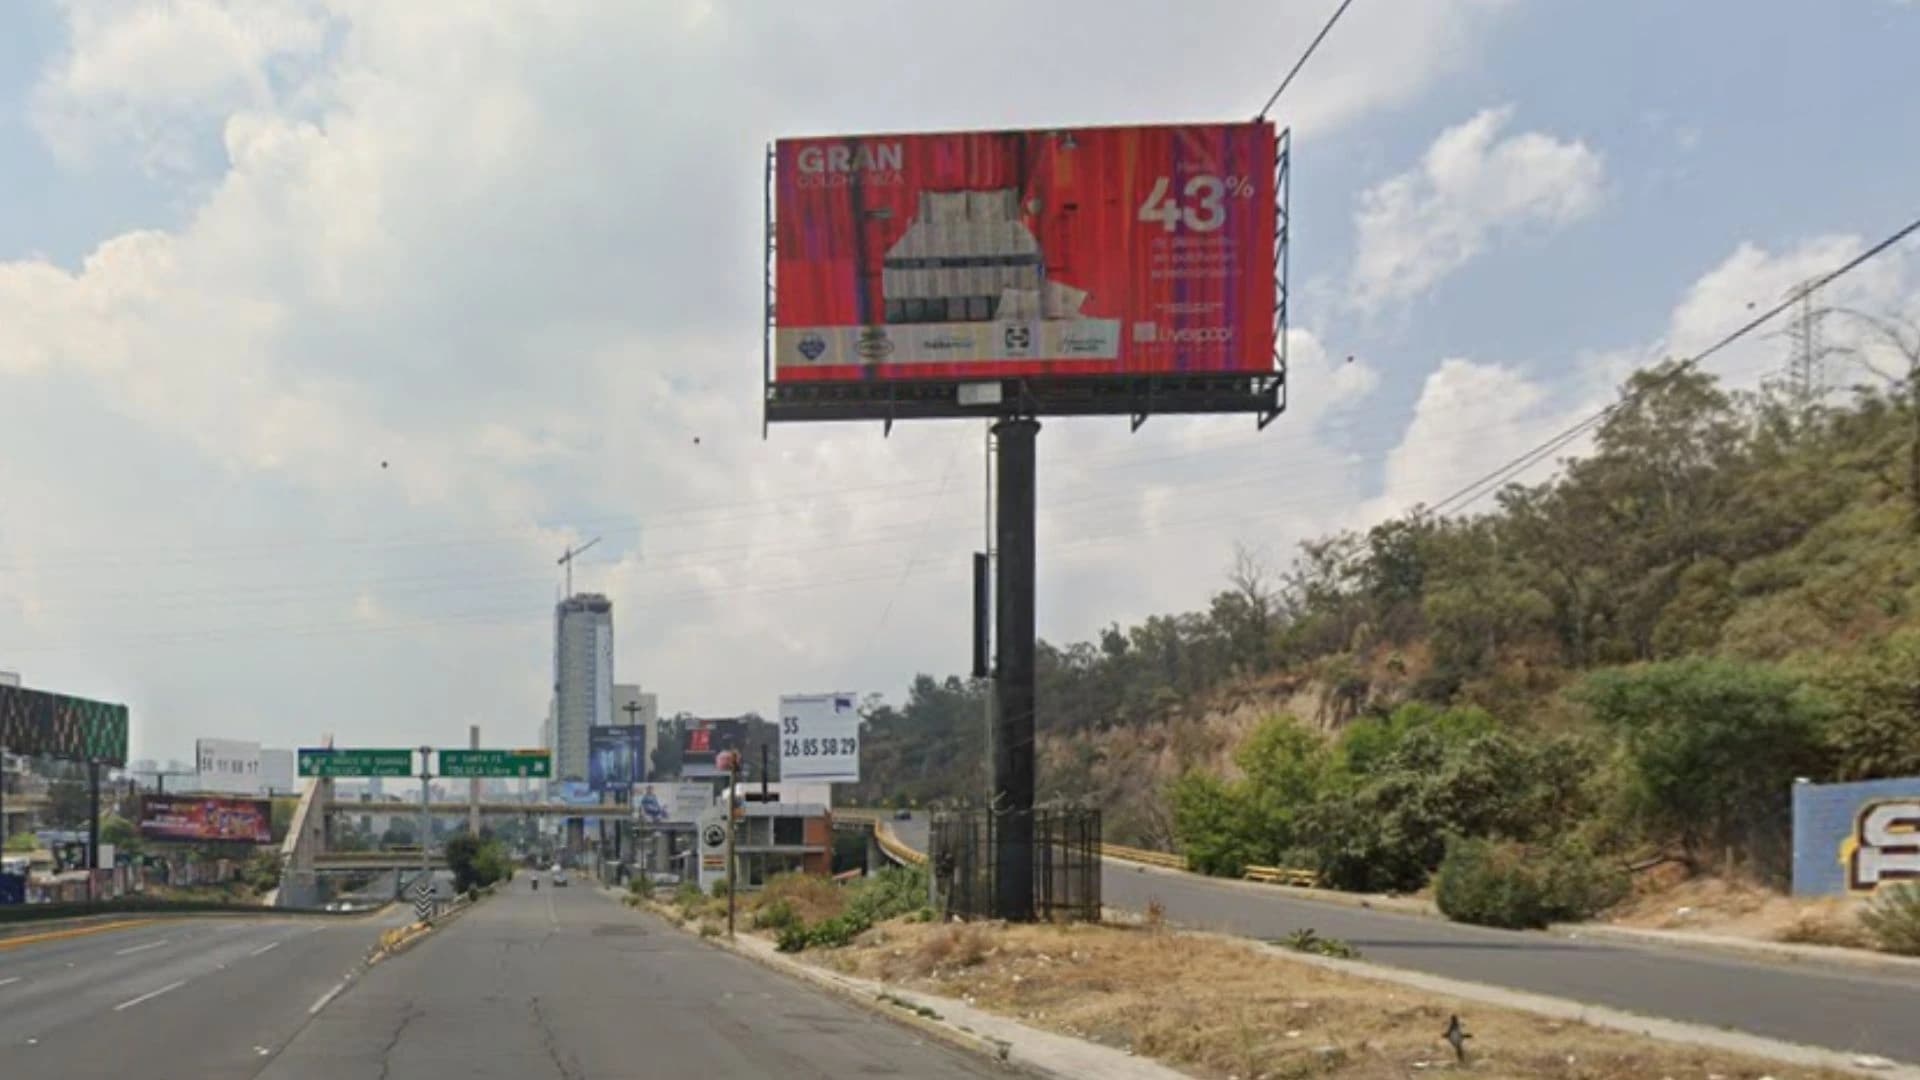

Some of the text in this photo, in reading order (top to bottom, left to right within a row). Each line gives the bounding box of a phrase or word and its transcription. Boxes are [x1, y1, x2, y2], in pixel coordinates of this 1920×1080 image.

[797, 142, 904, 174] GRAN
[784, 716, 799, 735] 55
[784, 738, 800, 757] 26
[840, 737, 856, 755] 29
